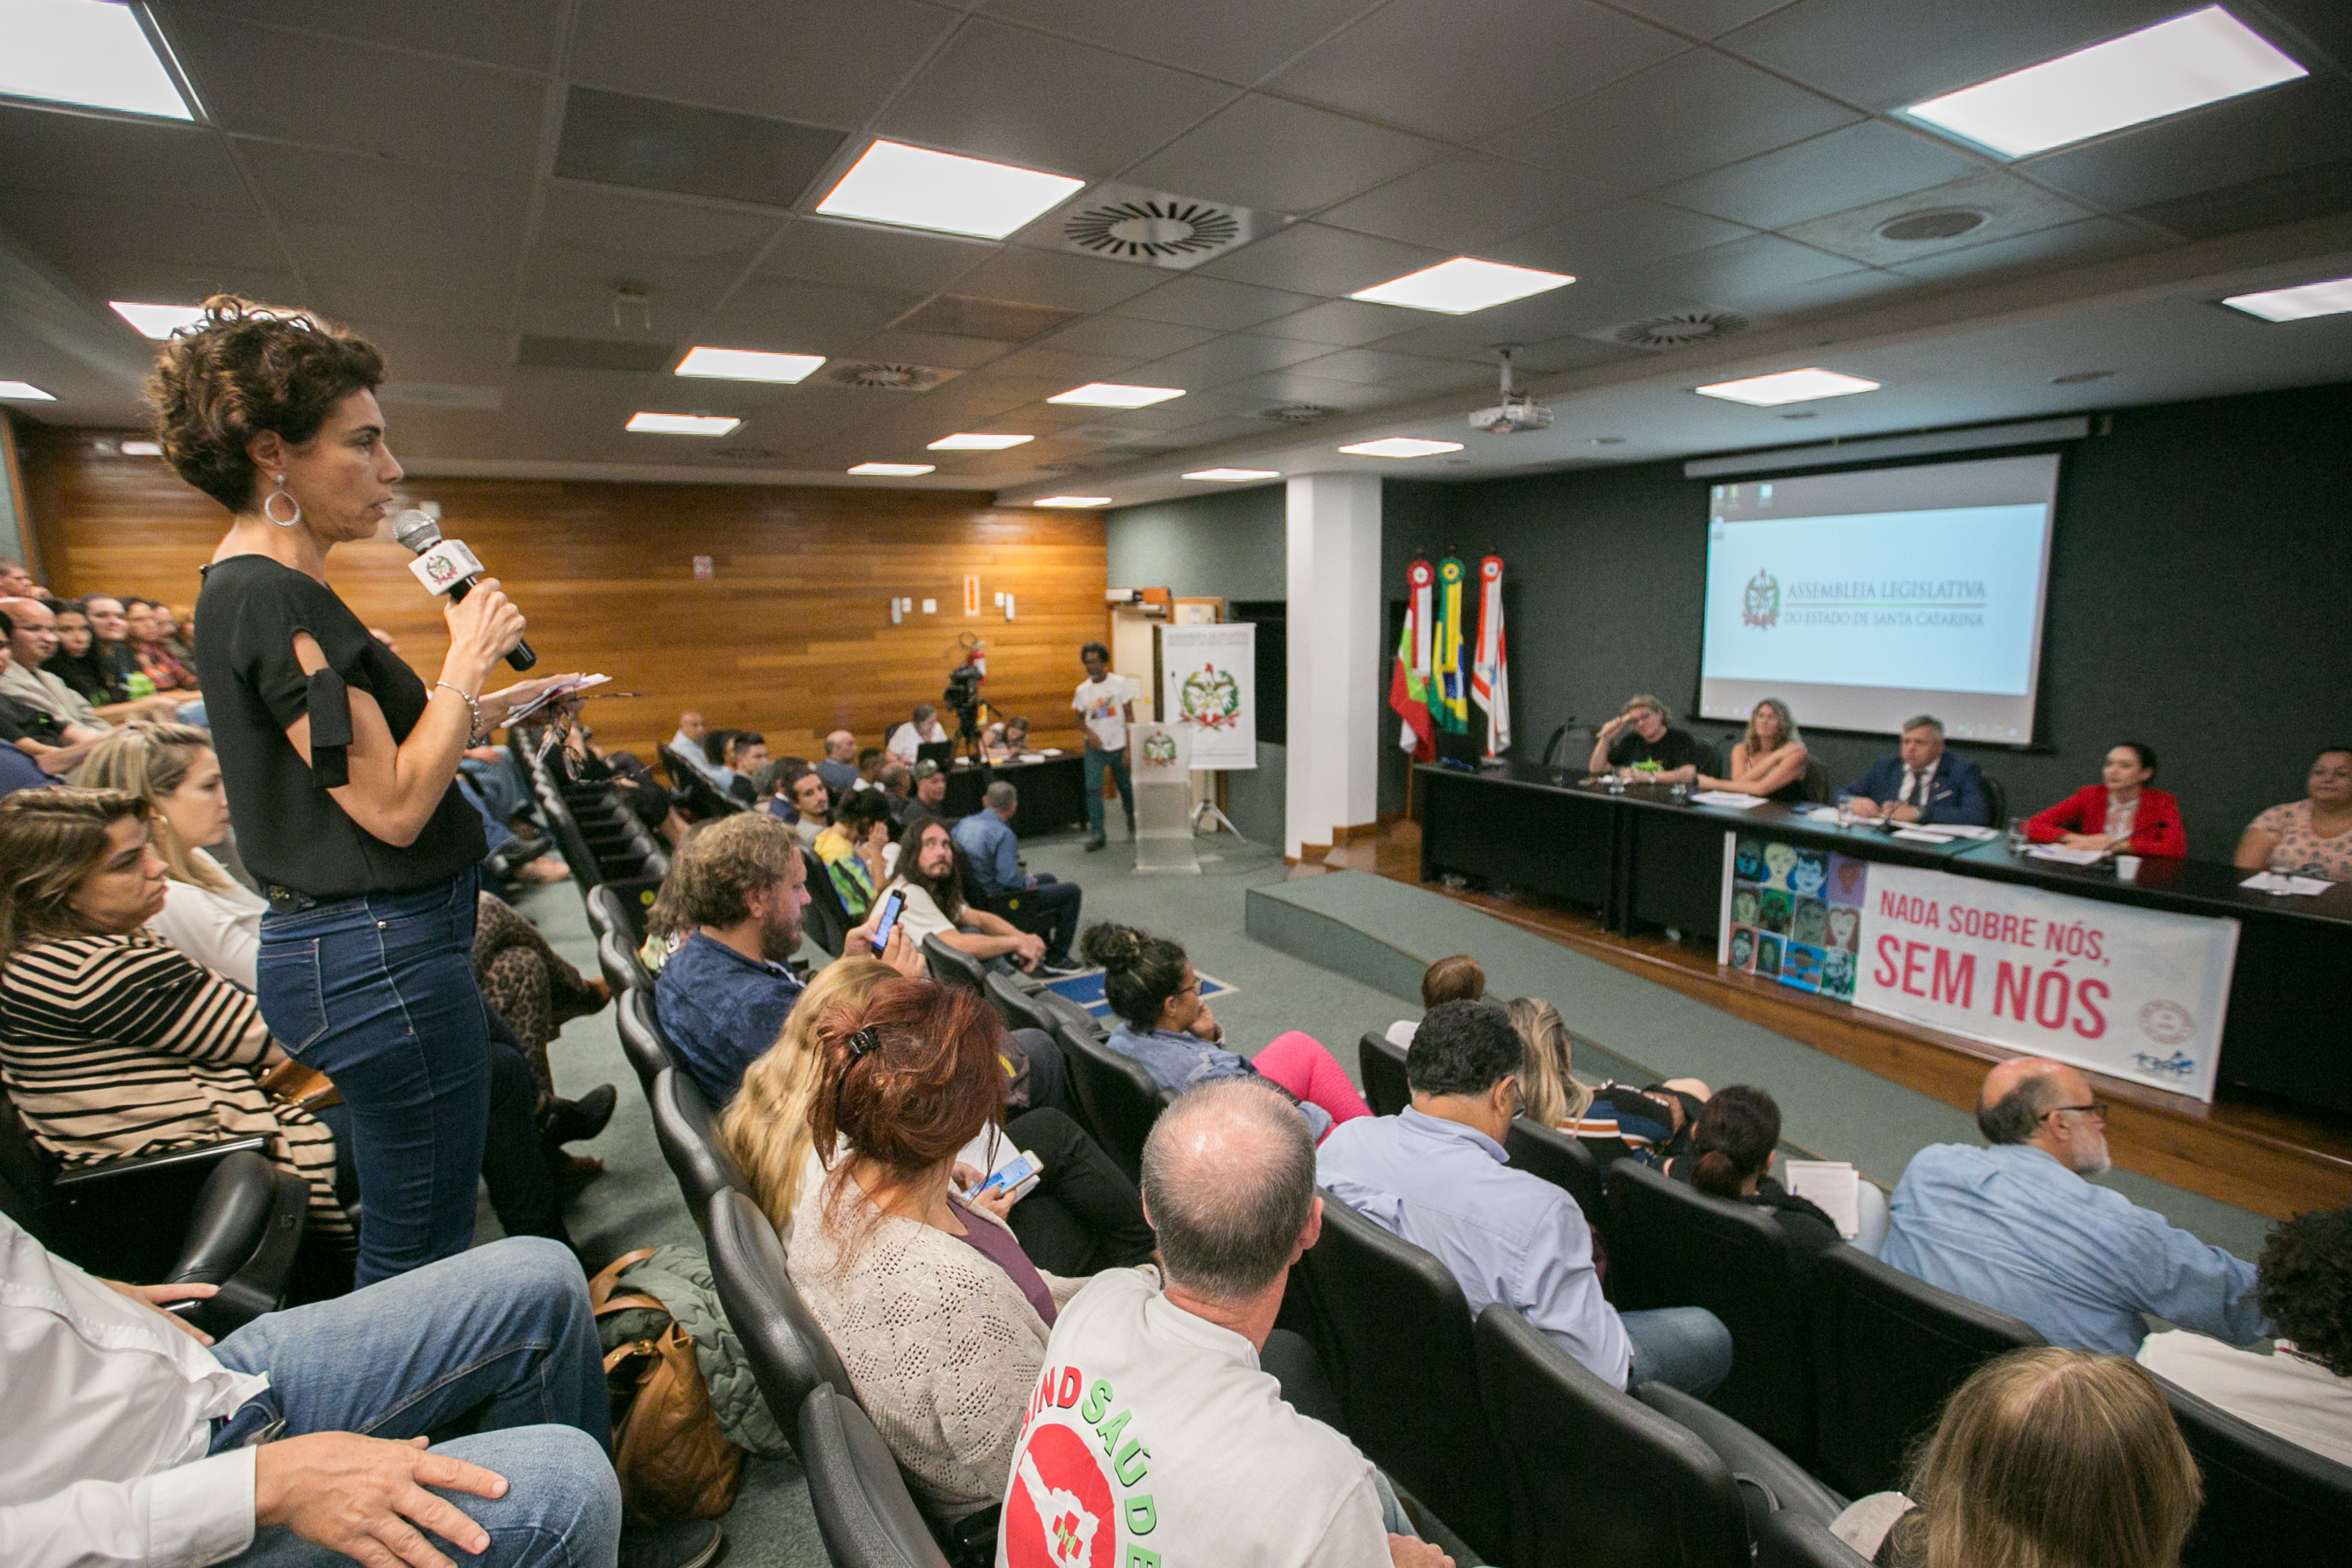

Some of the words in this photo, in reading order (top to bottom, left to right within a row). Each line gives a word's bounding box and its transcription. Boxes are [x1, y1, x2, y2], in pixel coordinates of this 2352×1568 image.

[1787, 581, 1875, 599] ASSEMBLEIA
[1881, 580, 1986, 599] LEGISLATIVA
[1784, 611, 1802, 624] DO
[1805, 611, 1851, 625] ESTADO
[1853, 611, 1868, 625] DE
[1872, 611, 1912, 626] SANTA
[1917, 612, 1985, 627] CATARINA
[1880, 890, 1940, 929] NADA
[1947, 905, 2038, 948] SOBRE
[2045, 920, 2111, 966] NÓS,
[1874, 933, 1977, 1010] SEM
[1992, 958, 2111, 1039] NÓS
